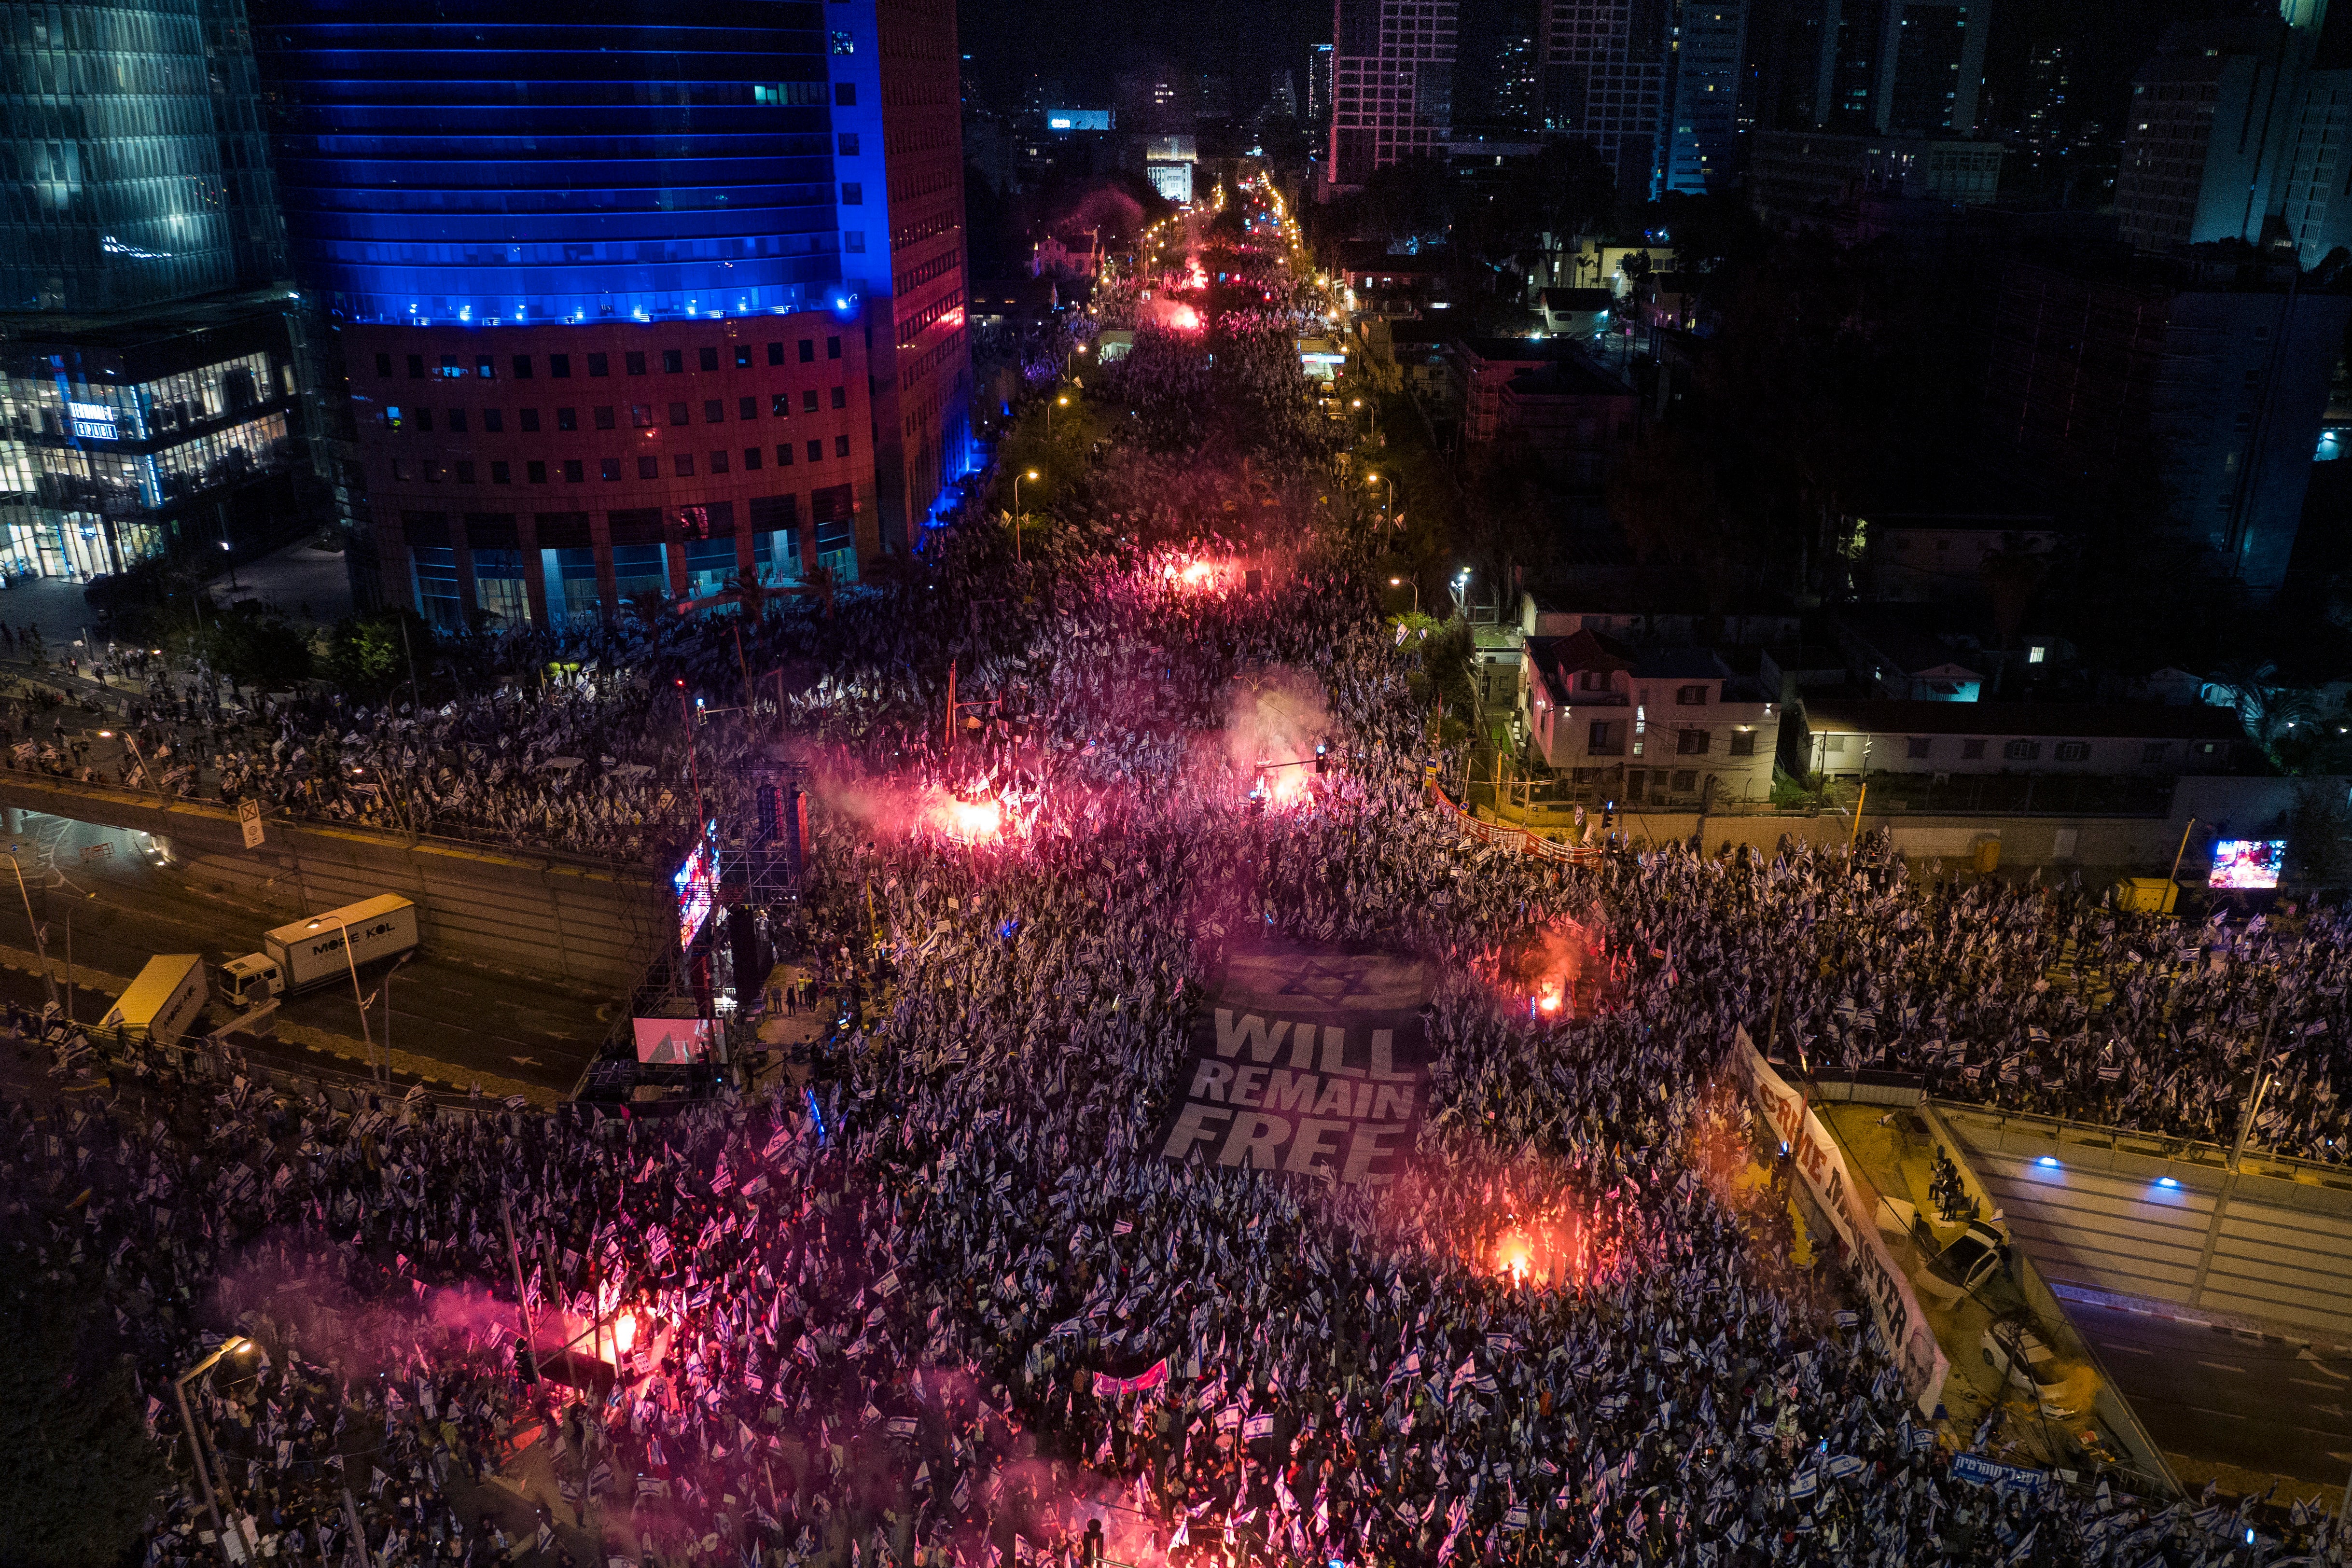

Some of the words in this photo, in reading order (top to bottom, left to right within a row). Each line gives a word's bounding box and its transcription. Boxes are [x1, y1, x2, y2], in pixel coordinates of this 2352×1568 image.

[78, 423, 113, 437] SPACE
[313, 933, 360, 956] MORE
[366, 923, 395, 938] KOL
[1215, 1008, 1416, 1082] WILL
[1189, 1058, 1415, 1120] REMAIN
[1164, 1102, 1406, 1185] FREE
[1760, 1083, 1827, 1185] CRIME
